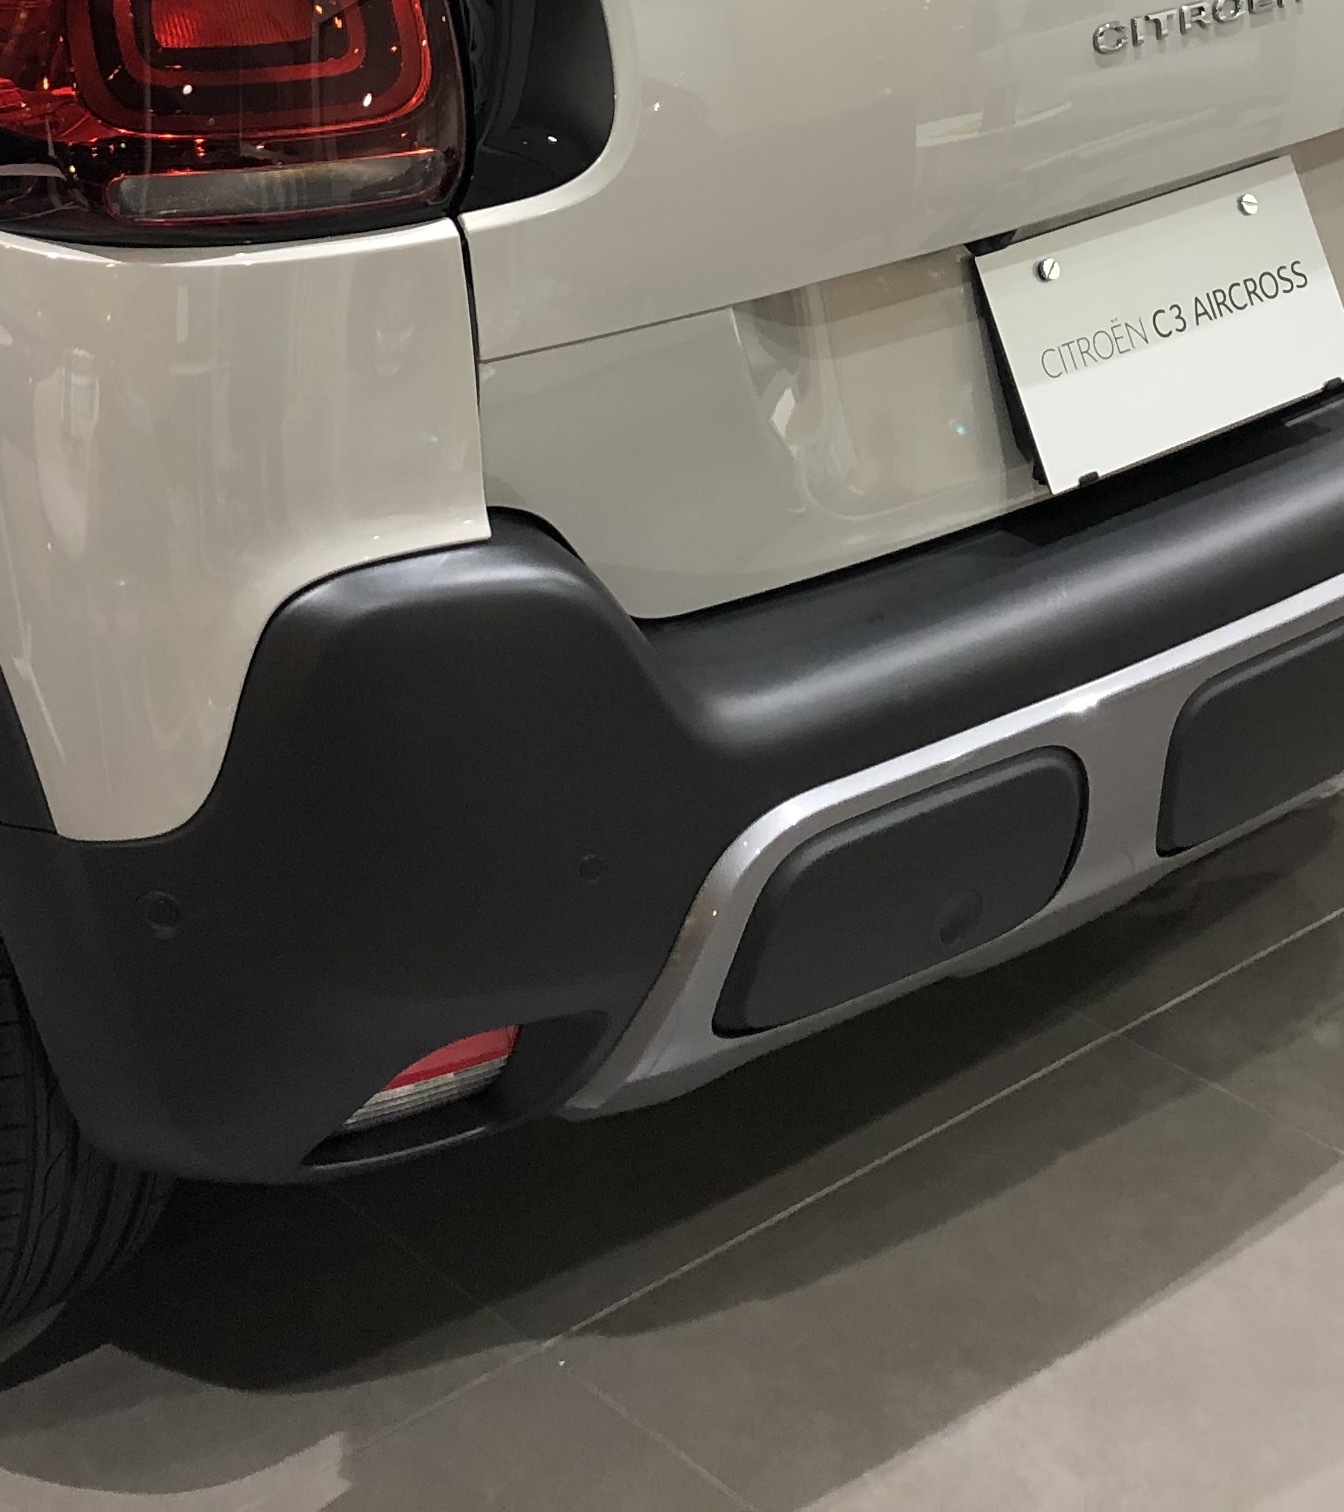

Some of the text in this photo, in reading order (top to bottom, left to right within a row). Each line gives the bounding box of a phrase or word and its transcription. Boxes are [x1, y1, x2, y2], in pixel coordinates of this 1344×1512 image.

[1041, 260, 1308, 378] CITROËN C3 AIRCROSS
